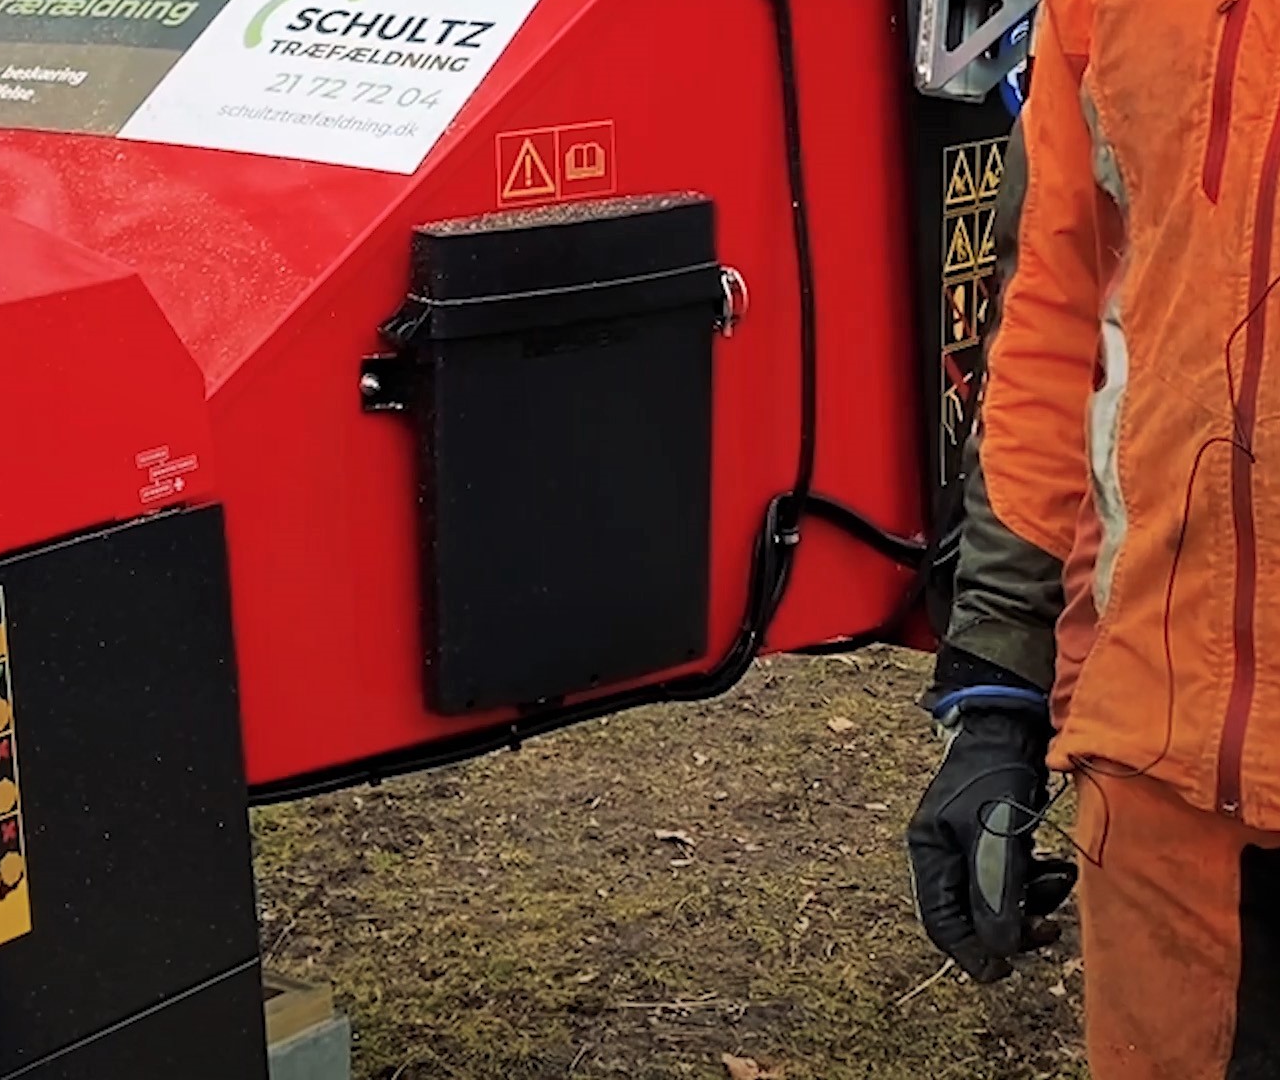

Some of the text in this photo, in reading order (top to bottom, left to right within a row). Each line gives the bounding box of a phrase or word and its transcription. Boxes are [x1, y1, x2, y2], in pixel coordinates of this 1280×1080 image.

[286, 7, 496, 48] SCHULTZ
[268, 39, 471, 73] TRÆFÆLDNING
[0, 64, 89, 87] beskæring
[264, 72, 443, 110] 21 72 72 04
[216, 103, 420, 139] schultztræfældning.dk
